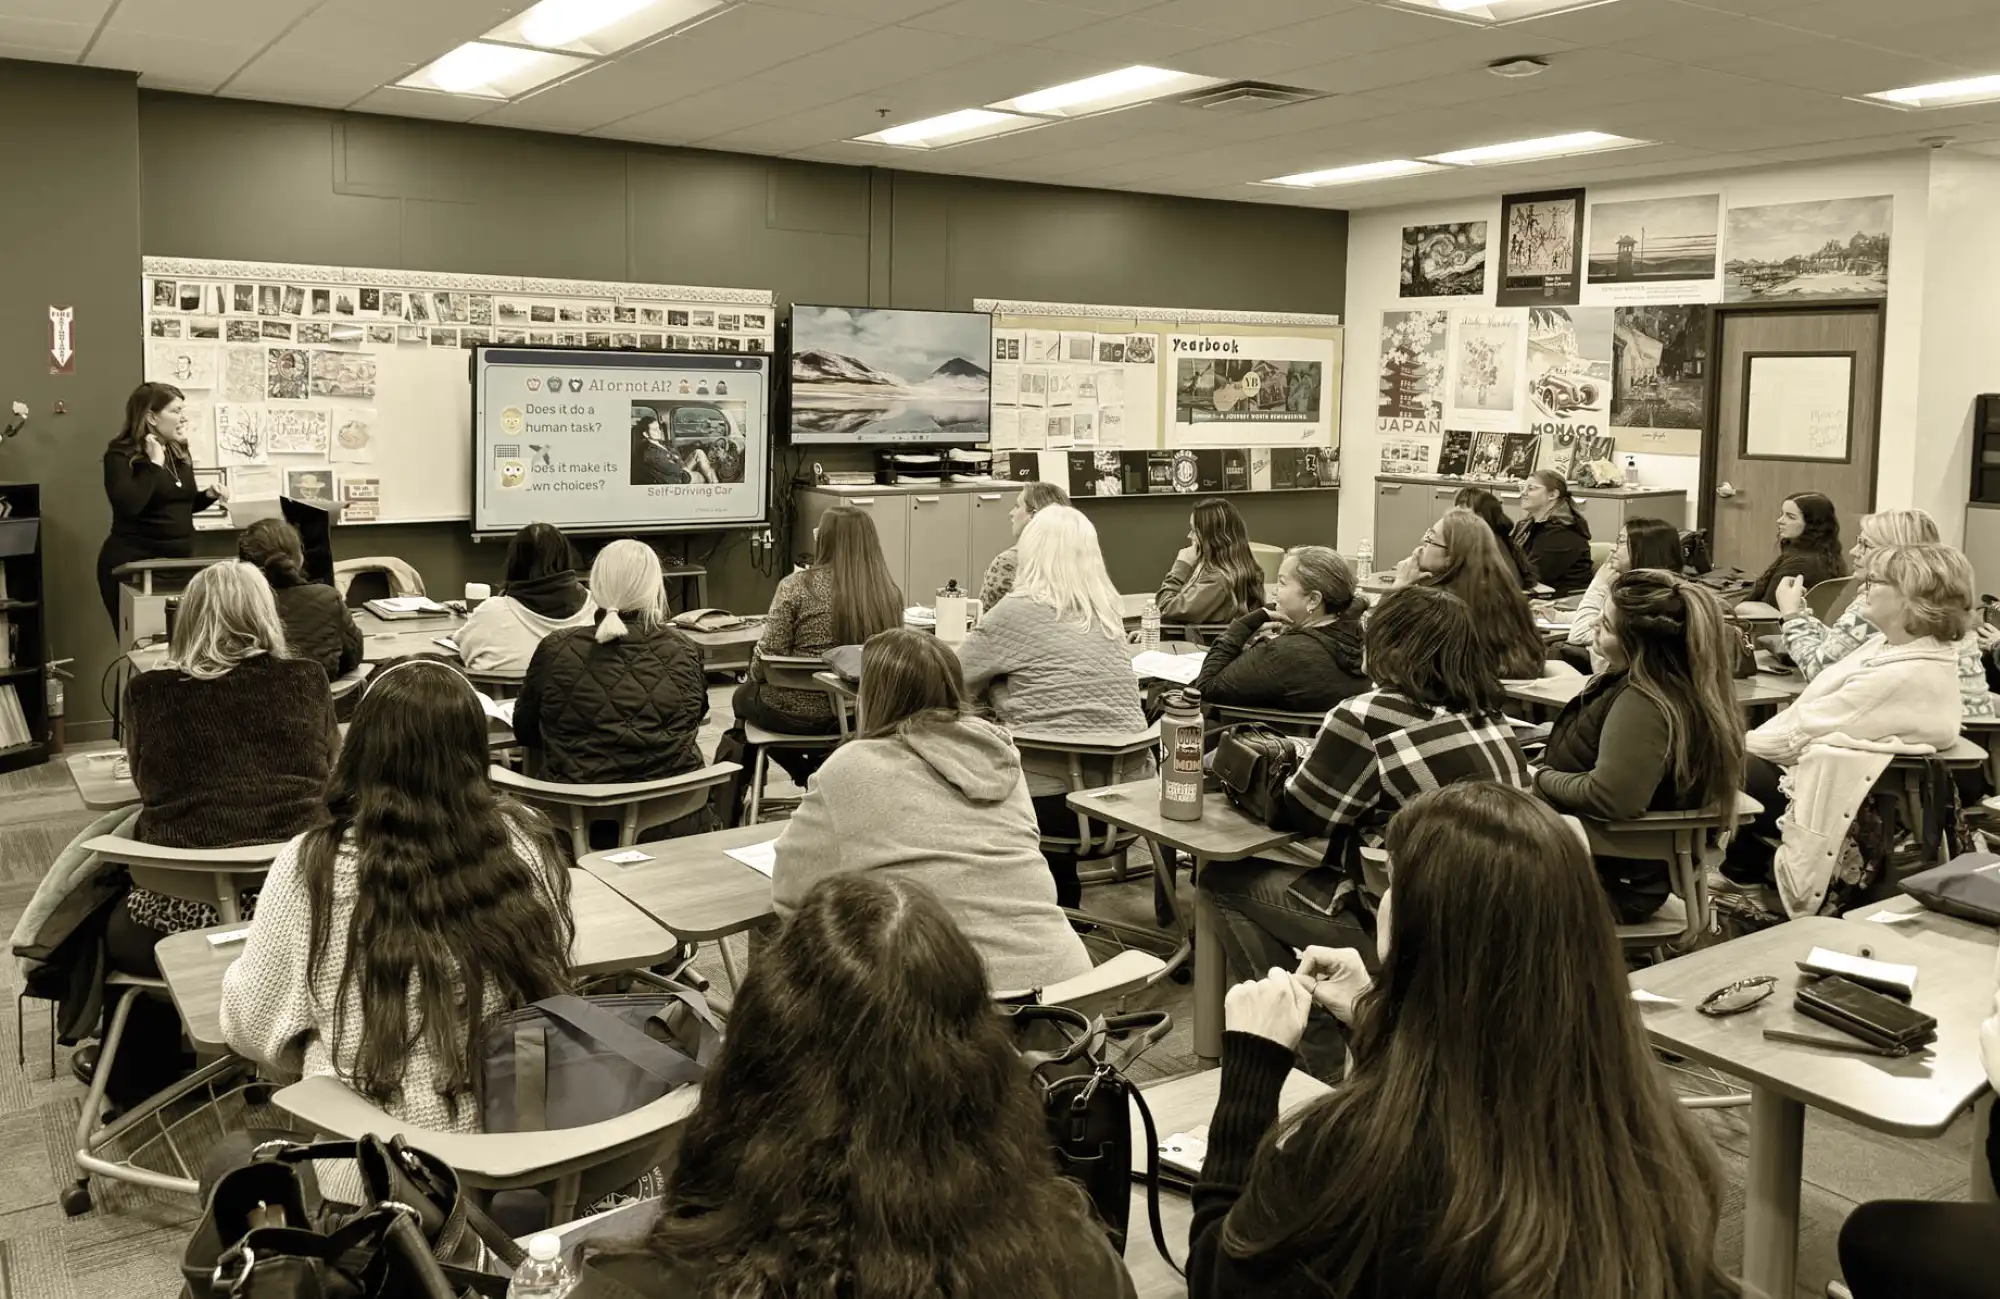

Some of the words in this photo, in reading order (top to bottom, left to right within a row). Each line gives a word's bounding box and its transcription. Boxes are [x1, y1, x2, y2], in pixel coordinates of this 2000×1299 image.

[588, 379, 604, 391] AI
[607, 382, 622, 391] or
[625, 381, 648, 391] not
[526, 404, 556, 416] Does
[559, 404, 566, 415] it
[570, 404, 585, 416] do
[588, 407, 595, 415] a
[526, 422, 567, 433] human
[571, 422, 602, 433] task?
[1379, 419, 1440, 434] JAPAN
[1531, 423, 1598, 436] MONACO
[559, 462, 567, 473] it
[570, 462, 600, 473] make
[603, 461, 618, 473] its
[526, 482, 550, 492] wn
[554, 480, 605, 492] choices?
[648, 486, 712, 498] Self-Driving
[715, 486, 732, 496] Car
